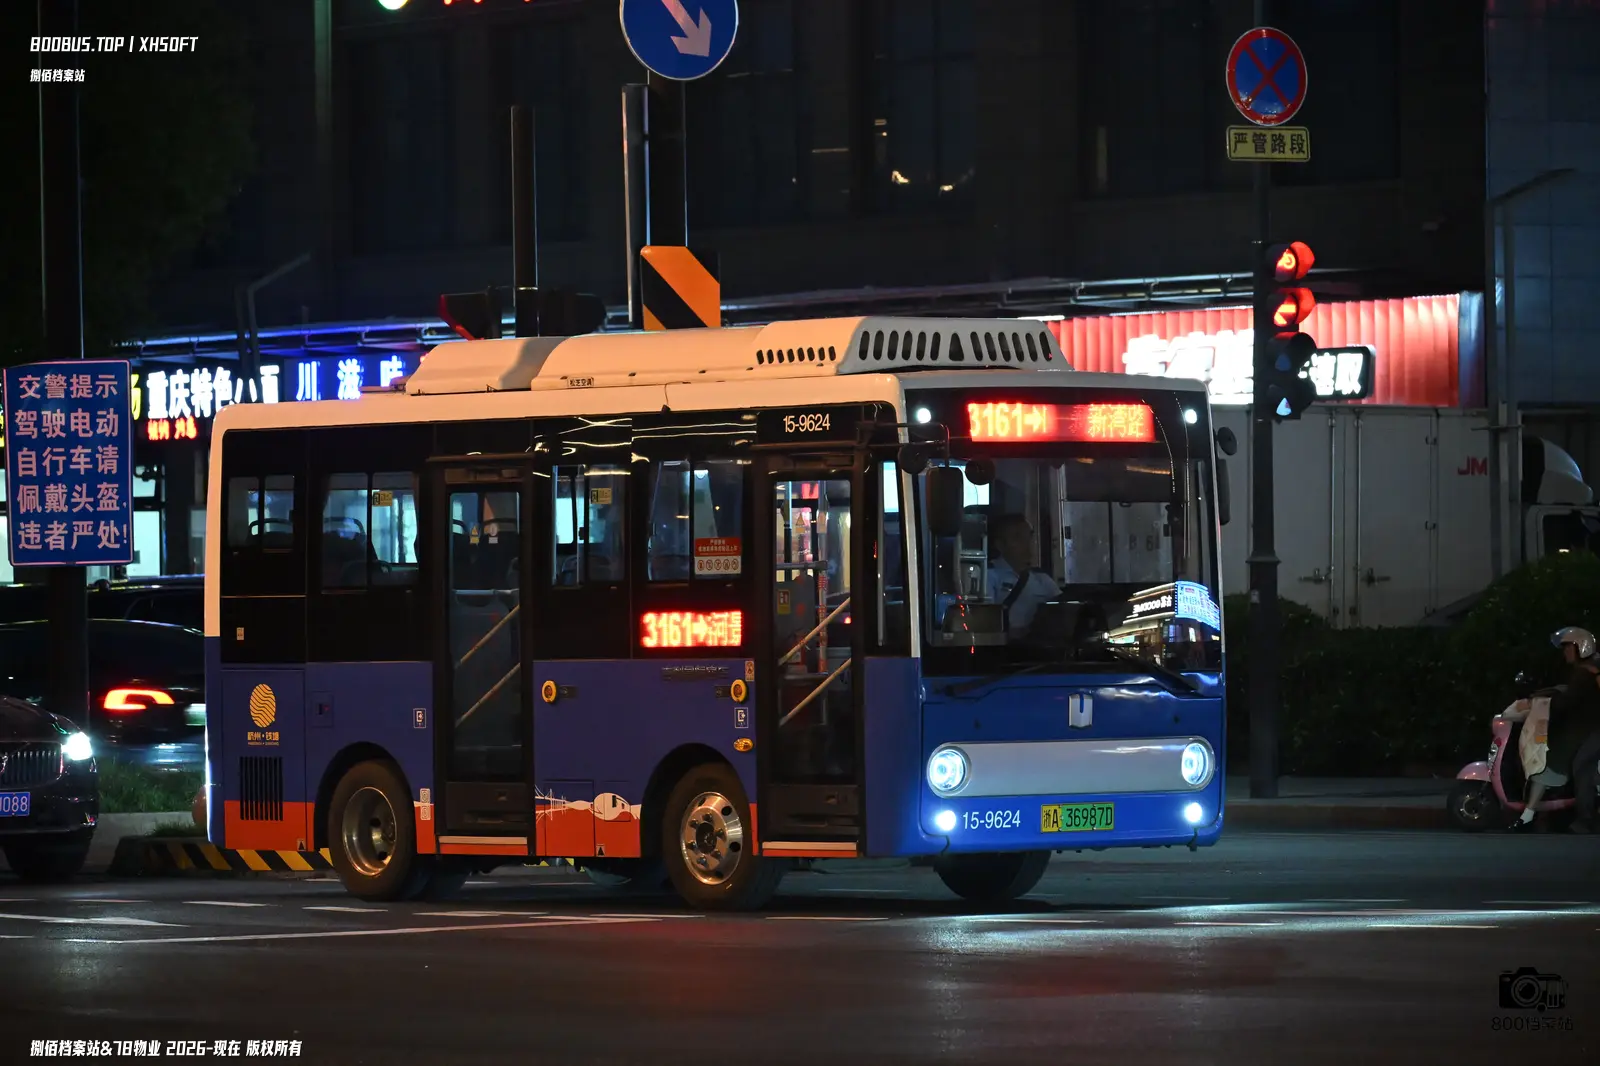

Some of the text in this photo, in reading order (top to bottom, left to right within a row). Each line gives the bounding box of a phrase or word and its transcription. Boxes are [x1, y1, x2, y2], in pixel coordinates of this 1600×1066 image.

[1233, 131, 1306, 155] 严管路段
[18, 373, 119, 400] 交警提示
[14, 407, 120, 440] 驾驶电动
[783, 413, 831, 433] 15-9624
[968, 402, 1023, 437] 3161
[16, 444, 120, 477] 自行车请
[18, 519, 128, 551] 违者严处！
[642, 612, 692, 647] 3161
[962, 810, 1021, 830] 15-9624
[1065, 806, 1113, 828] 36987D
